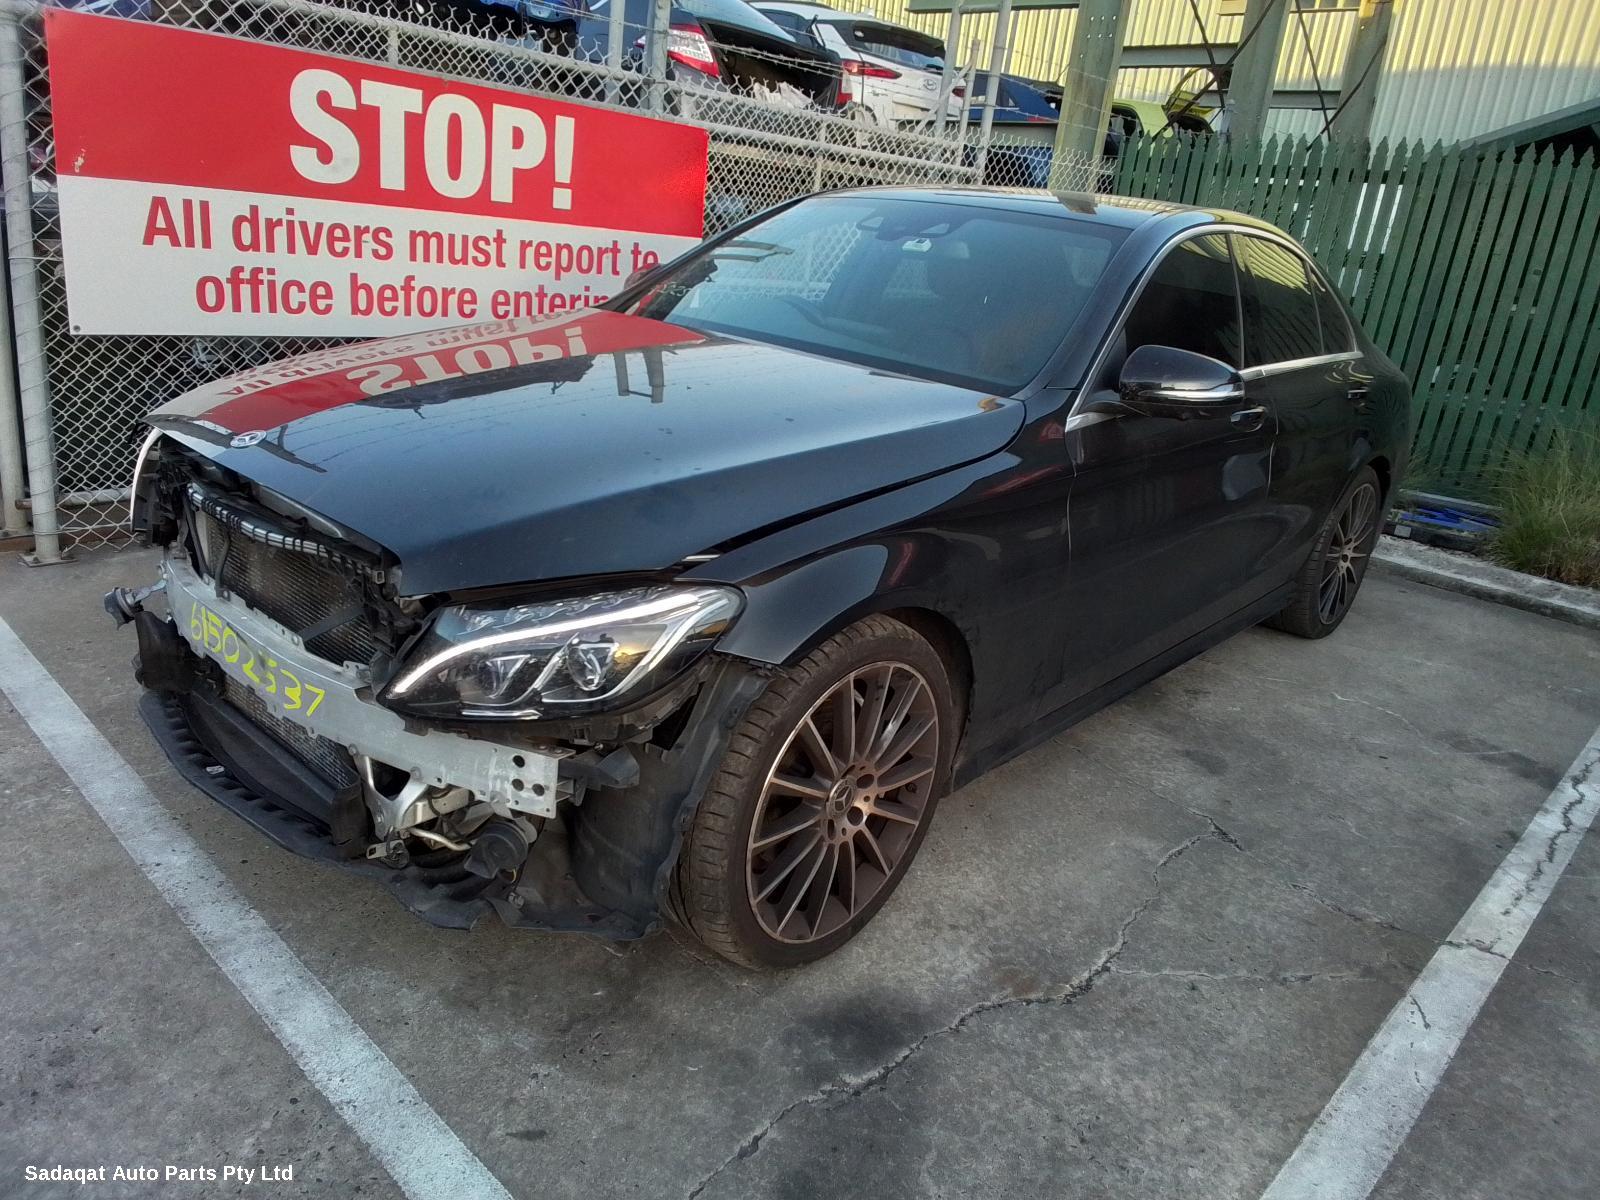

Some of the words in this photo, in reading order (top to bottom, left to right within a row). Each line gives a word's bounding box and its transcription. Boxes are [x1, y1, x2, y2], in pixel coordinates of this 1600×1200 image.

[290, 68, 575, 210] STOP!
[142, 195, 213, 249] All
[231, 204, 394, 261] drivers
[409, 229, 507, 268] must
[519, 239, 621, 281] report
[631, 242, 660, 273] to
[195, 266, 334, 316] office
[350, 273, 478, 319] before
